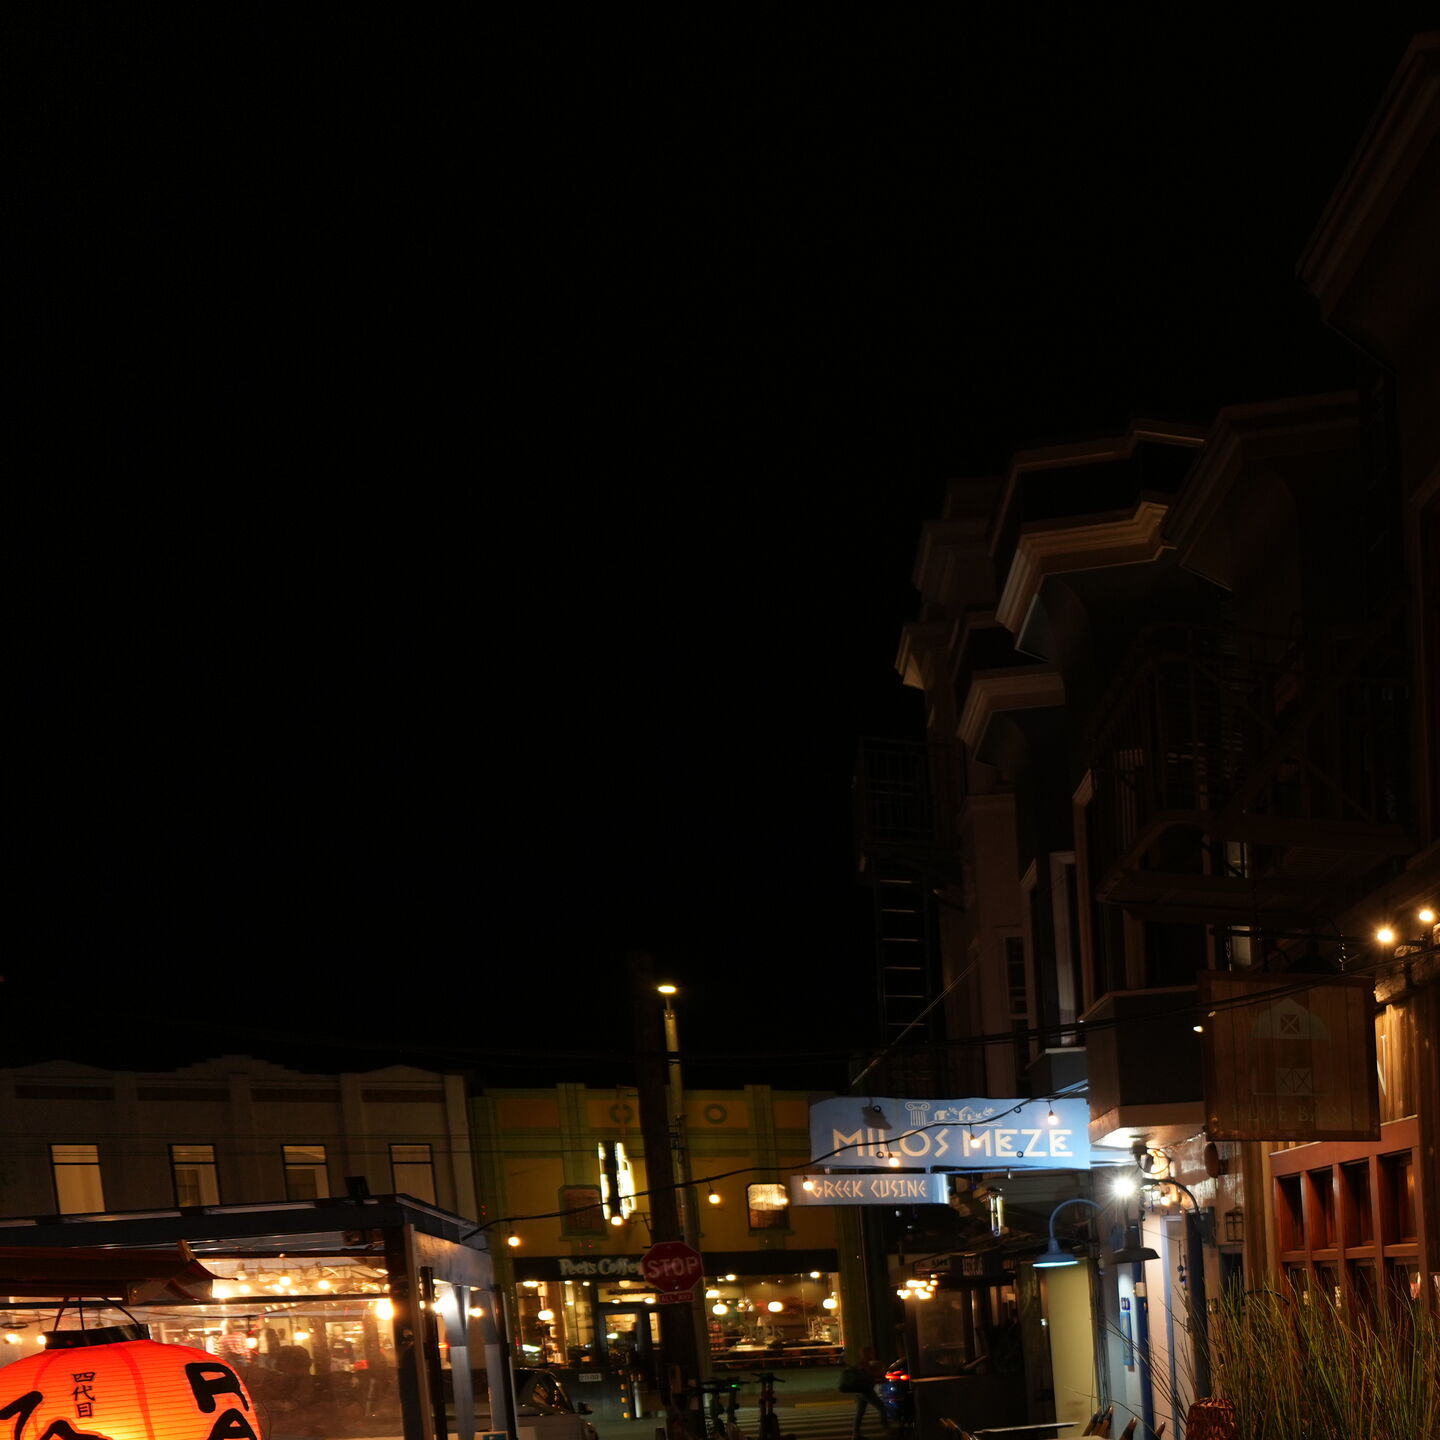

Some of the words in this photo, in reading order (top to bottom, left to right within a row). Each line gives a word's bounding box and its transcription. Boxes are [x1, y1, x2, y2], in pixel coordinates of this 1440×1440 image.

[962, 1129, 1073, 1157] MEZE
[811, 1179, 864, 1199] GREEK
[647, 1255, 699, 1279] STOP
[71, 1371, 97, 1418] 四代目
